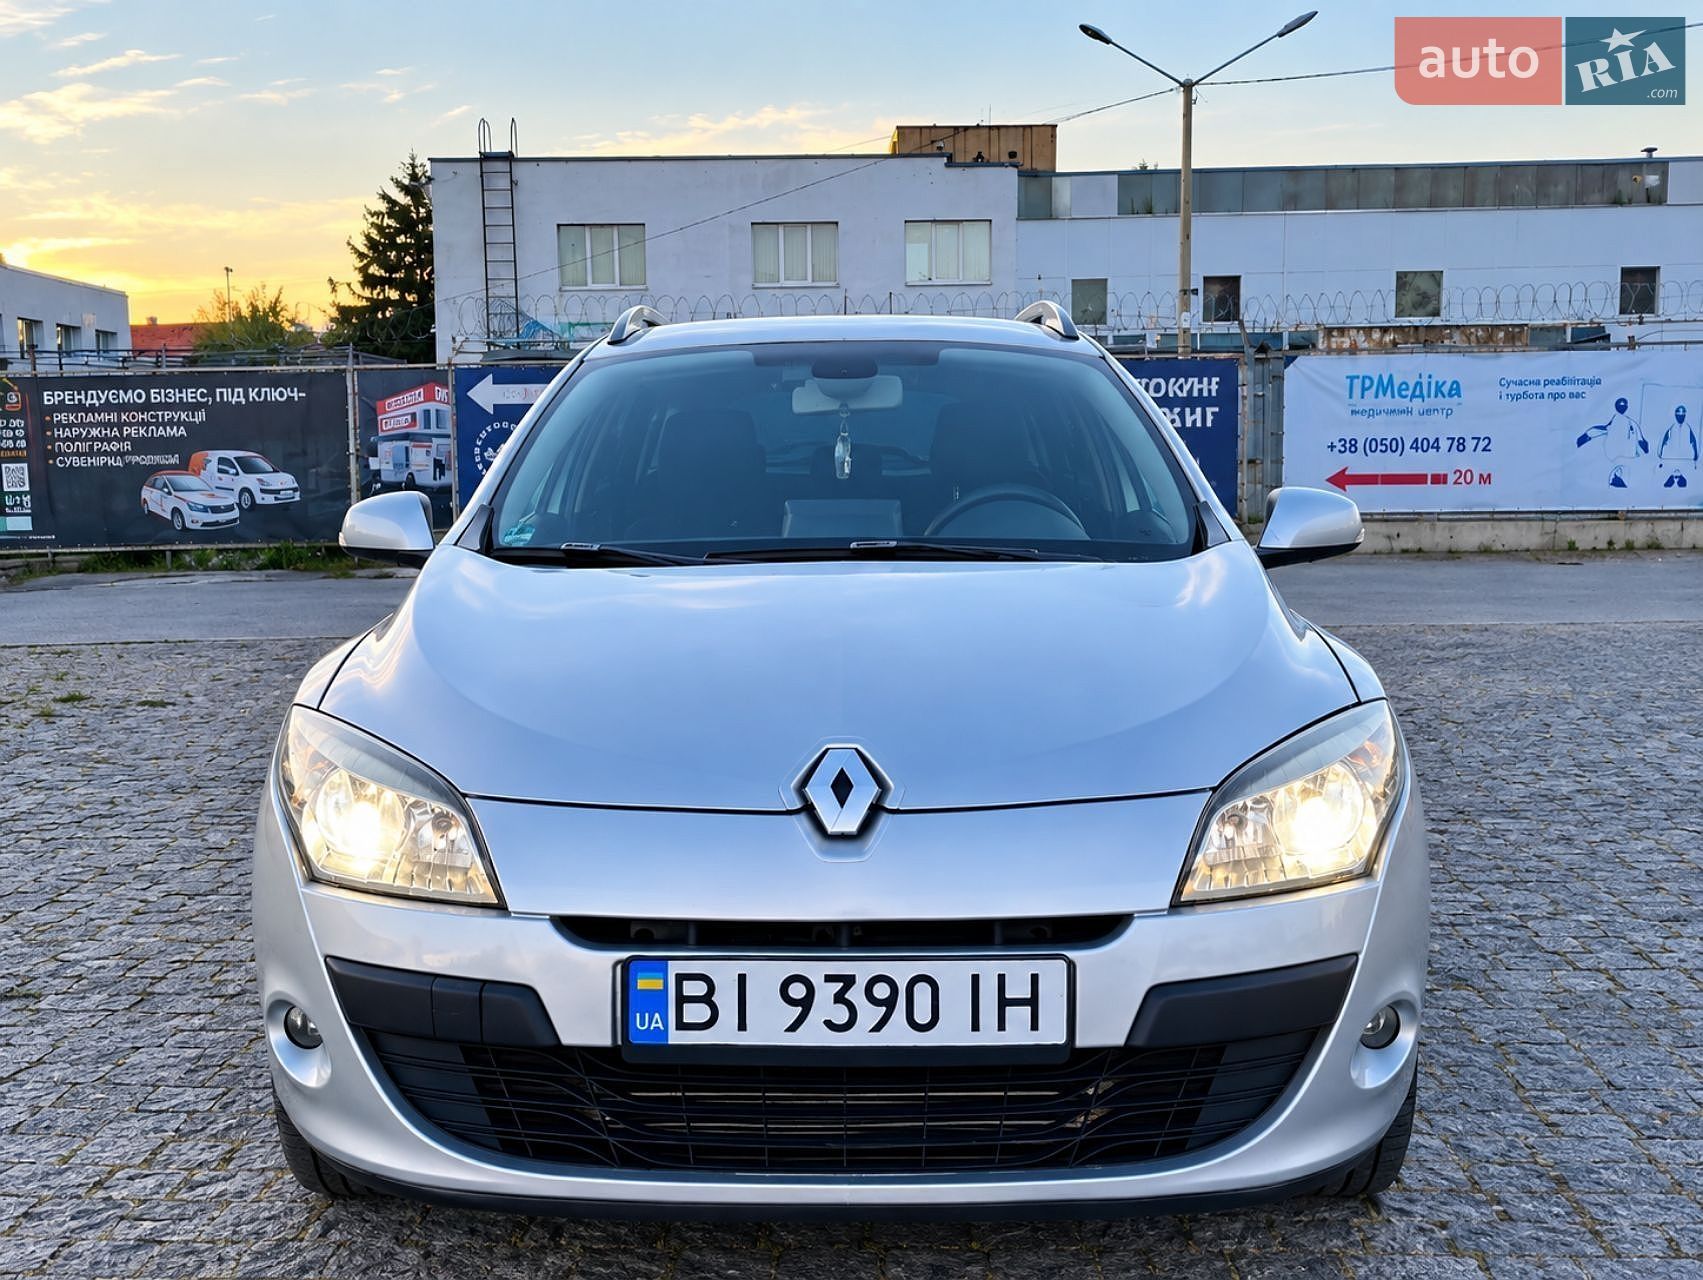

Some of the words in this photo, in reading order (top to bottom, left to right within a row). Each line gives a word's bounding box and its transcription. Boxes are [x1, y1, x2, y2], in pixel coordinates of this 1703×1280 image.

[43, 389, 146, 407] БРЕНДУЄМО
[150, 388, 212, 405] БІЗНЕС,
[216, 387, 246, 405] ПІД
[1547, 392, 1566, 401] про
[53, 412, 118, 424] РЕКЛАМНІ
[121, 409, 206, 424] КОНСТРУКЦІЇ
[54, 427, 120, 439] НАРУЖНА
[123, 426, 188, 438] РЕКЛАМА
[1327, 438, 1358, 454] +38
[1363, 437, 1405, 456] (050)
[1410, 437, 1441, 453] 404
[1446, 437, 1466, 452] 78
[1471, 436, 1492, 452] 72
[1453, 469, 1474, 485] 20
[674, 973, 748, 1032] BI
[779, 974, 940, 1033] 9390
[970, 973, 1040, 1032] IH
[636, 1012, 664, 1031] UA
